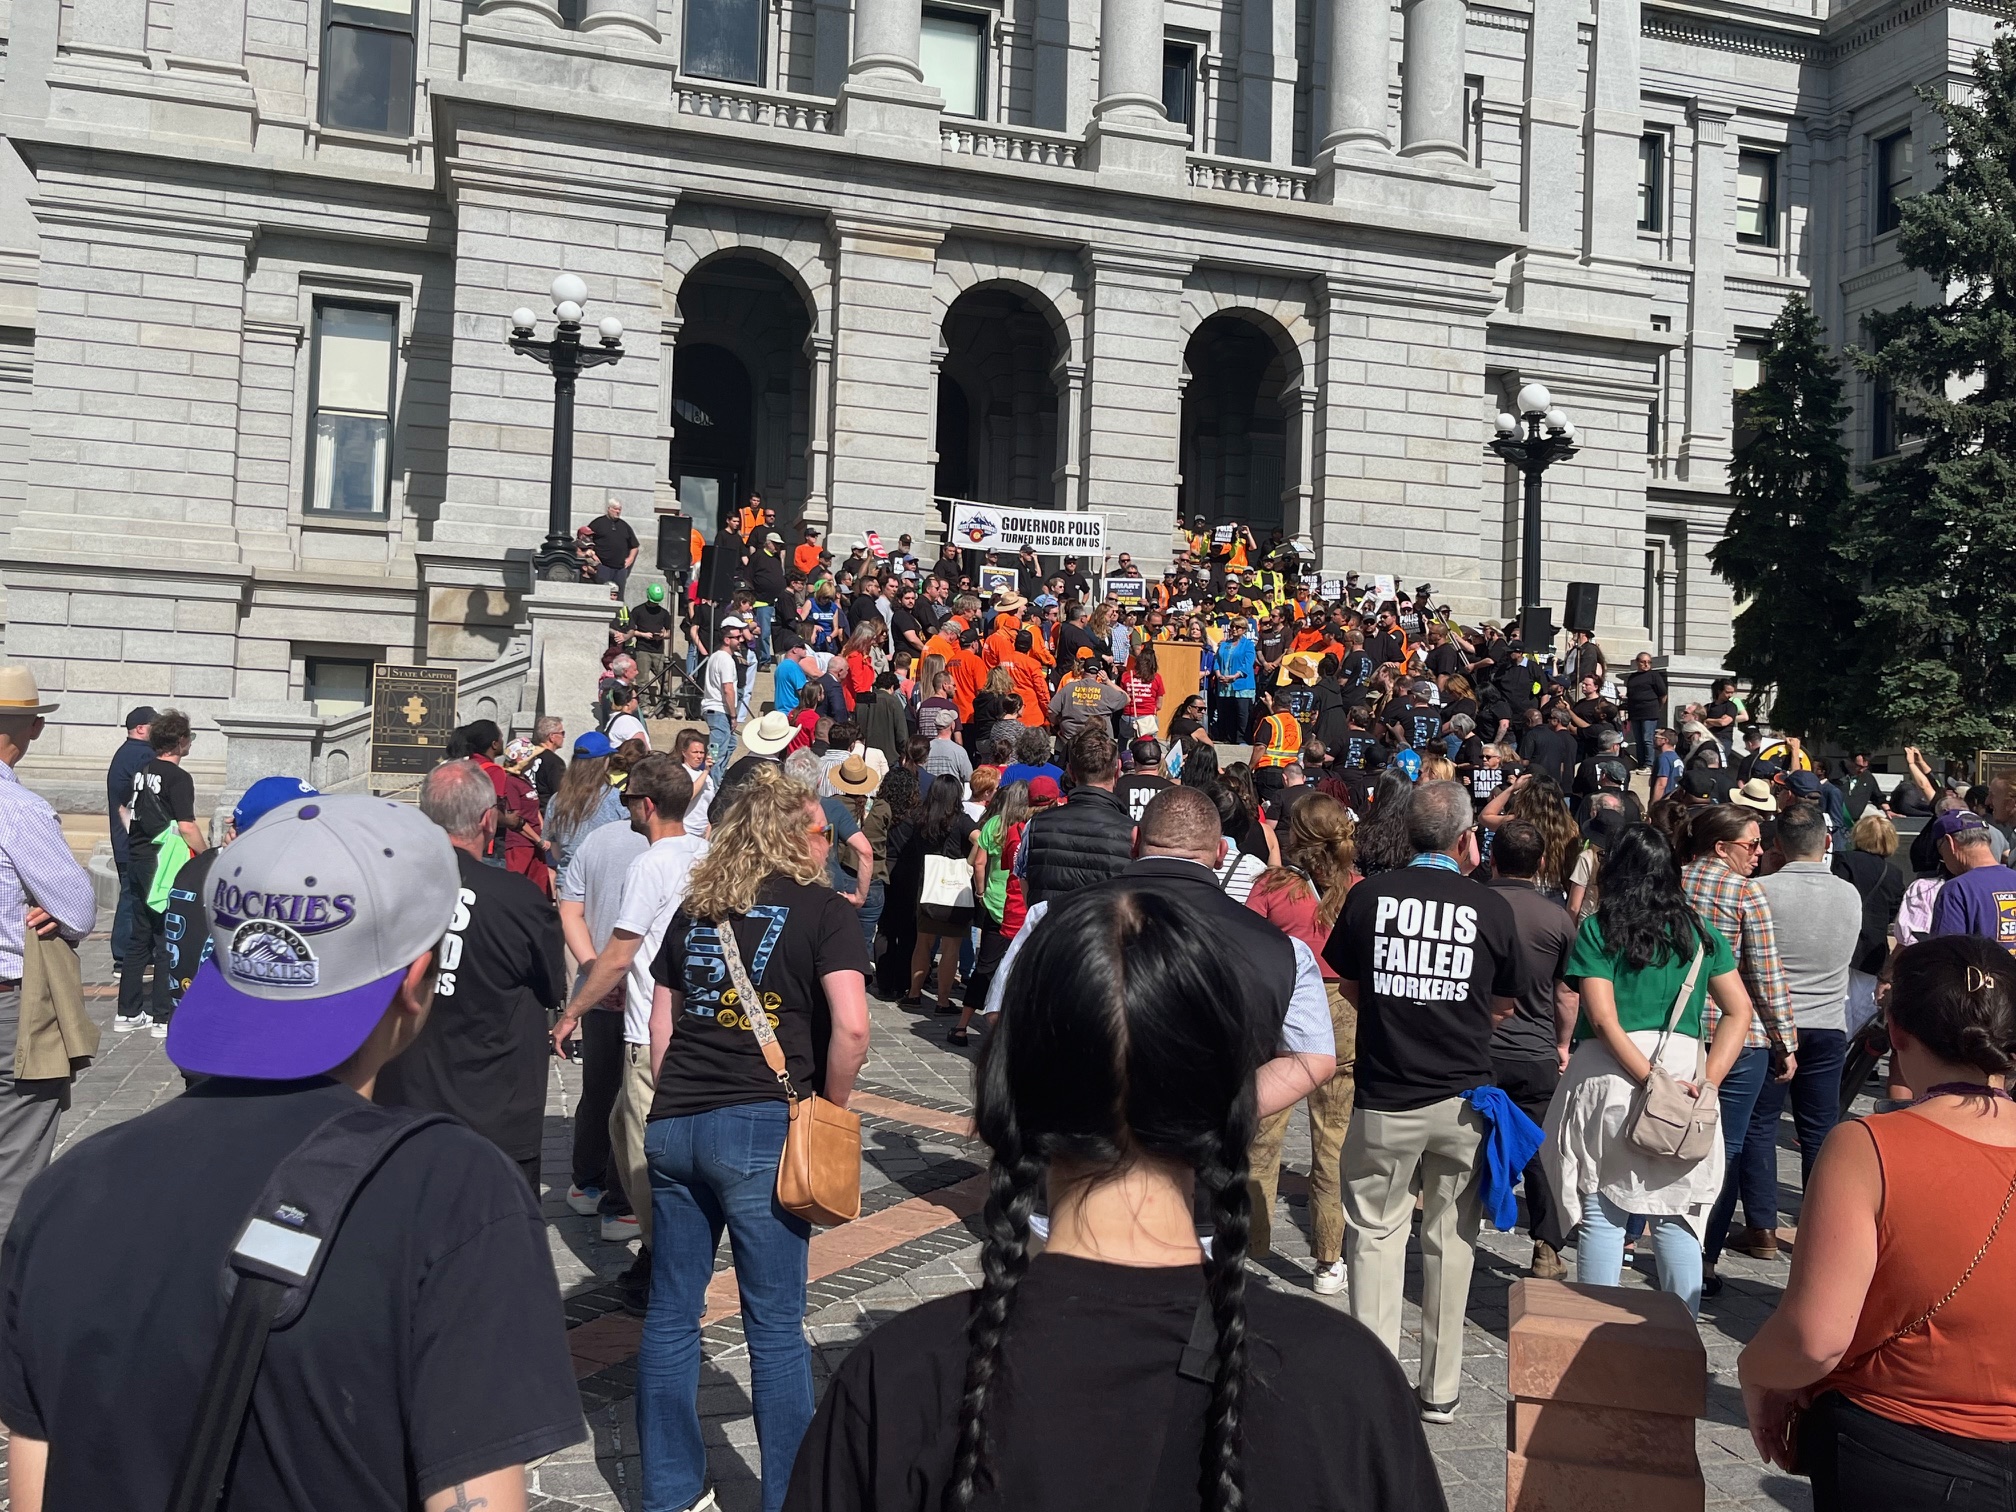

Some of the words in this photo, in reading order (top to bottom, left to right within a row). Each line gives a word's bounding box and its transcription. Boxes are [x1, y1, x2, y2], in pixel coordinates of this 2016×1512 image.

[1001, 516, 1066, 534] GOVERNOR
[1068, 521, 1100, 536] POLIS
[1001, 532, 1034, 545] TURNED
[1036, 535, 1051, 546] HIS
[1052, 536, 1075, 547] BACK
[1076, 537, 1088, 548] ON
[1089, 537, 1100, 548] US
[1300, 575, 1318, 583] POLIS
[1400, 613, 1419, 623] POLIS
[1473, 769, 1503, 781] POLIS
[213, 877, 356, 926] ROCKIES
[1374, 896, 1478, 944] POLIS
[234, 922, 308, 956] COLORADO
[745, 904, 790, 986] 7
[231, 951, 316, 980] ROCKIES
[1373, 935, 1474, 980] FAILED
[1373, 971, 1470, 1002] WORKERS
